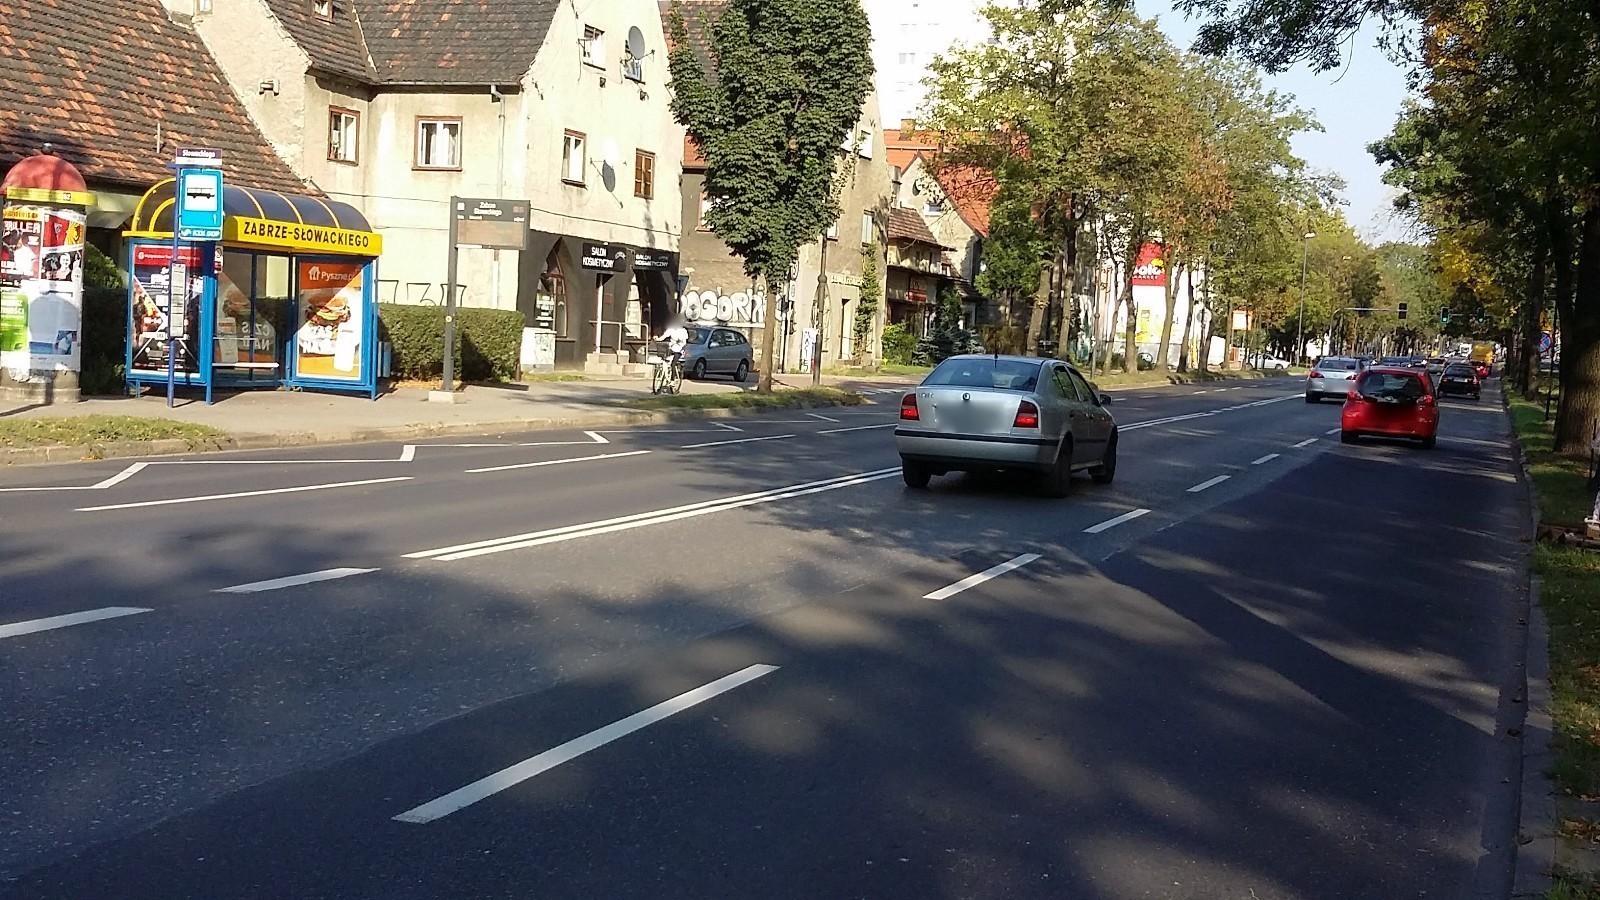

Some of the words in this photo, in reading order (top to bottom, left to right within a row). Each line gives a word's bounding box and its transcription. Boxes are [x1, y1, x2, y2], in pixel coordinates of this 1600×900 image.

[244, 222, 370, 248] ZABRZE-SŁOWACKIEGO
[591, 247, 607, 257] SALON
[582, 257, 615, 269] KOSMETYCZNY
